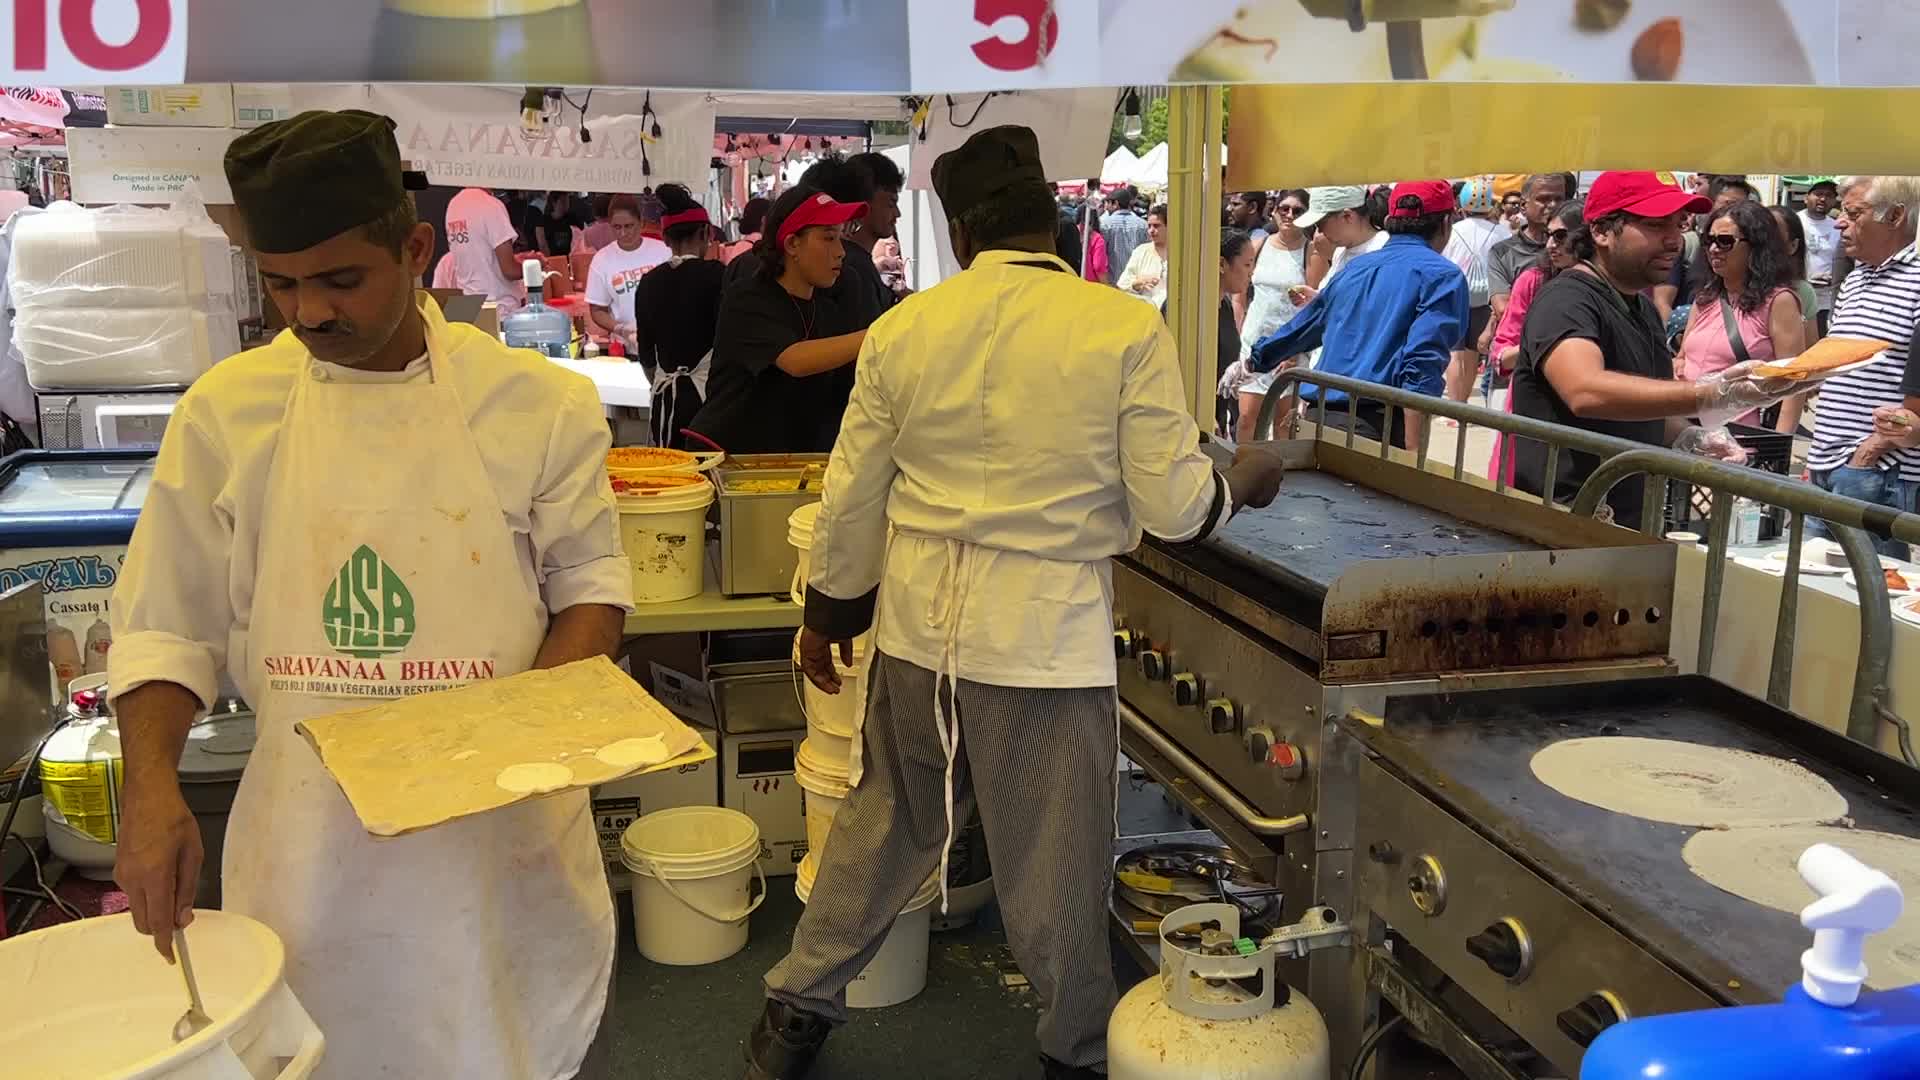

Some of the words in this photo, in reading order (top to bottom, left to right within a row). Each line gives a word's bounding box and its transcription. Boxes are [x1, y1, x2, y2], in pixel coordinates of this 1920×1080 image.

[970, 0, 1059, 72] 5
[265, 656, 386, 681] SARAVANAA
[401, 660, 494, 681] BHAVAN
[307, 681, 337, 692] INDIAN
[341, 682, 401, 697] VEGETARIAN
[603, 817, 612, 828] 4
[600, 832, 619, 841] 1000
